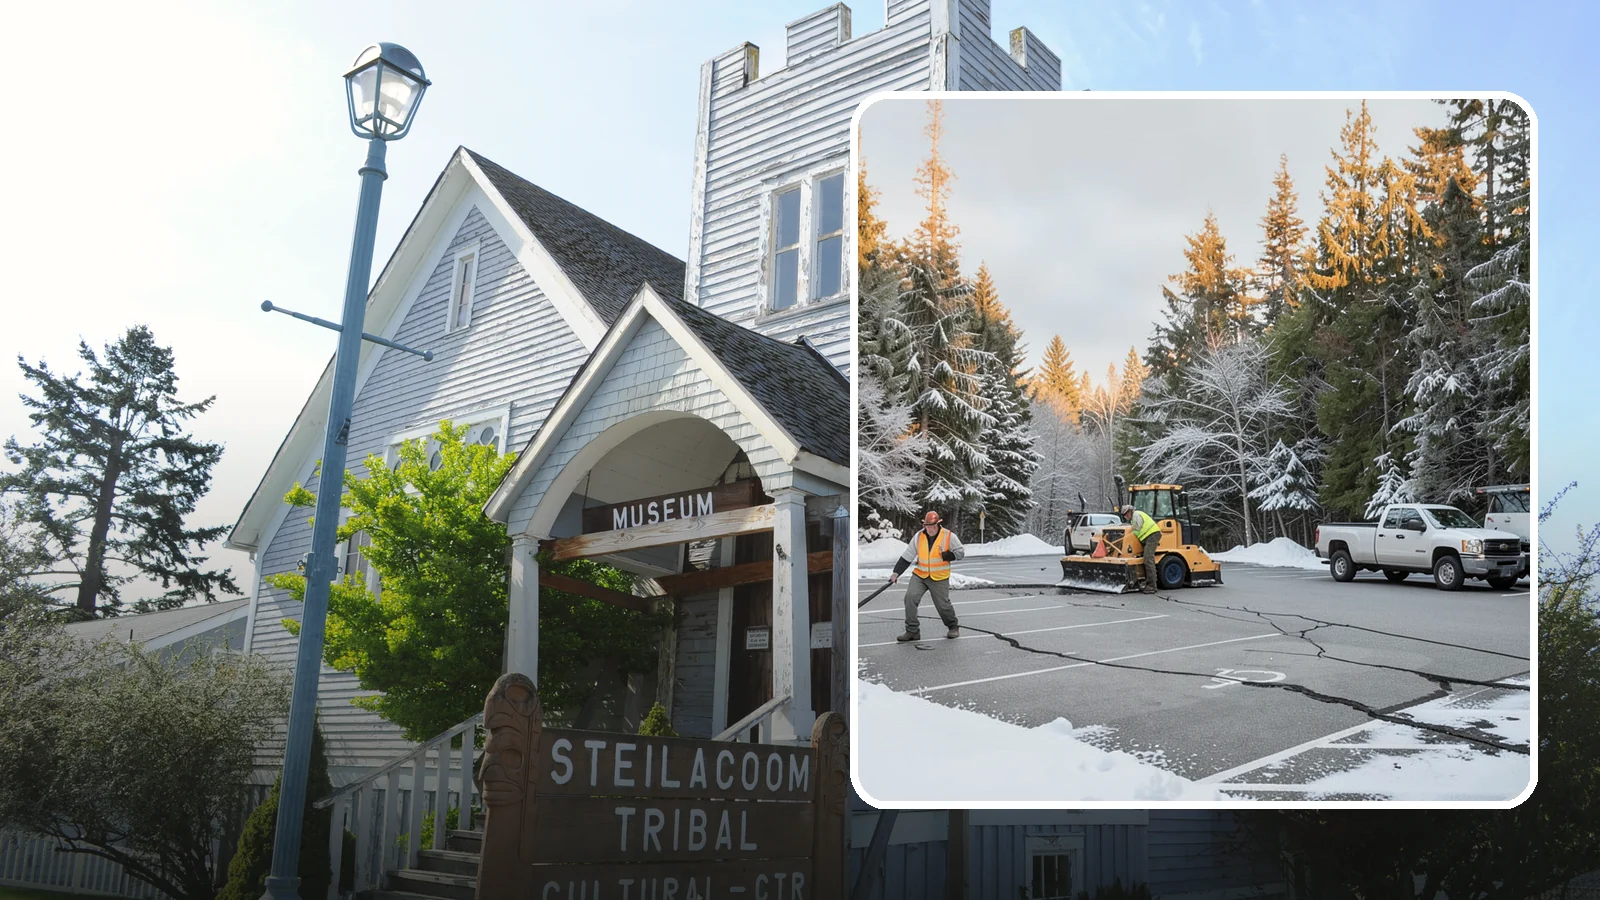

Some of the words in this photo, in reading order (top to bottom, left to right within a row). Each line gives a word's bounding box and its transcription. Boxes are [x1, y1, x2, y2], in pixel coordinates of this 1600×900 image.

[613, 491, 714, 531] MUSEUM
[550, 738, 809, 792] STEILACOOM
[614, 806, 758, 852] TRIBAL
